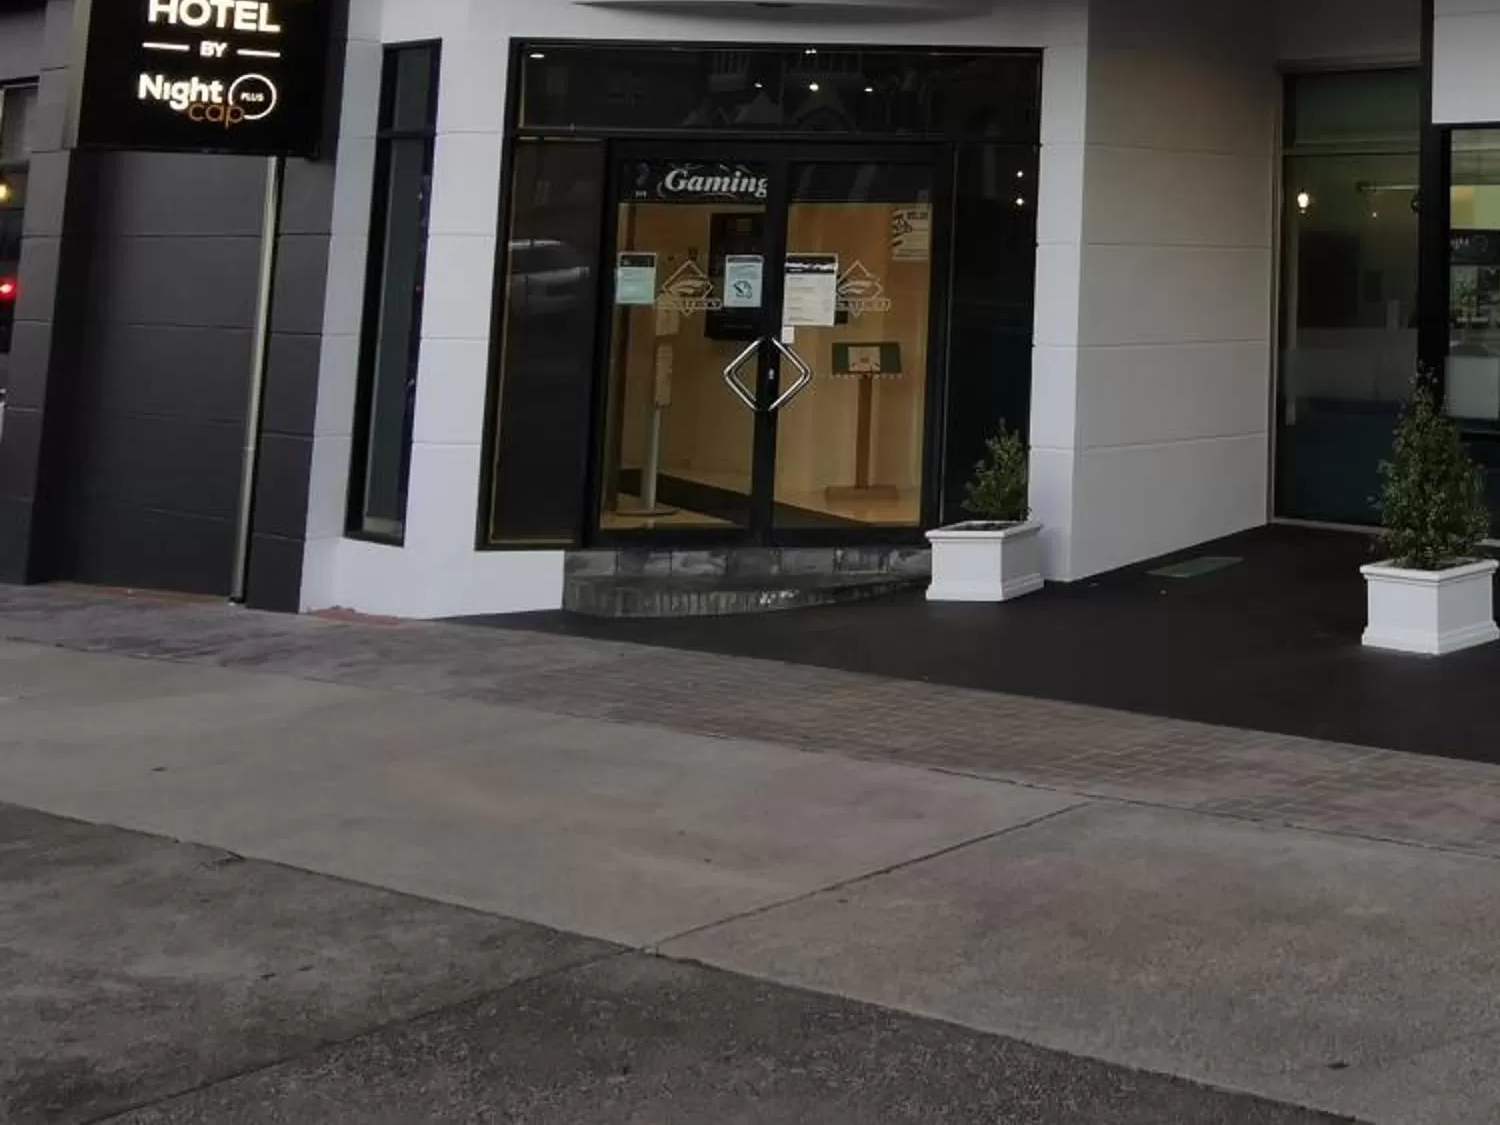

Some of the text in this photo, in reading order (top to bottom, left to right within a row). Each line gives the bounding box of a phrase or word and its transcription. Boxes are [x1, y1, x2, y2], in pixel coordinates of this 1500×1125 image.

[199, 40, 227, 58] BY
[138, 74, 223, 111] Night
[240, 92, 265, 102] PLUS
[188, 102, 245, 128] cap
[664, 168, 768, 198] Gaming
